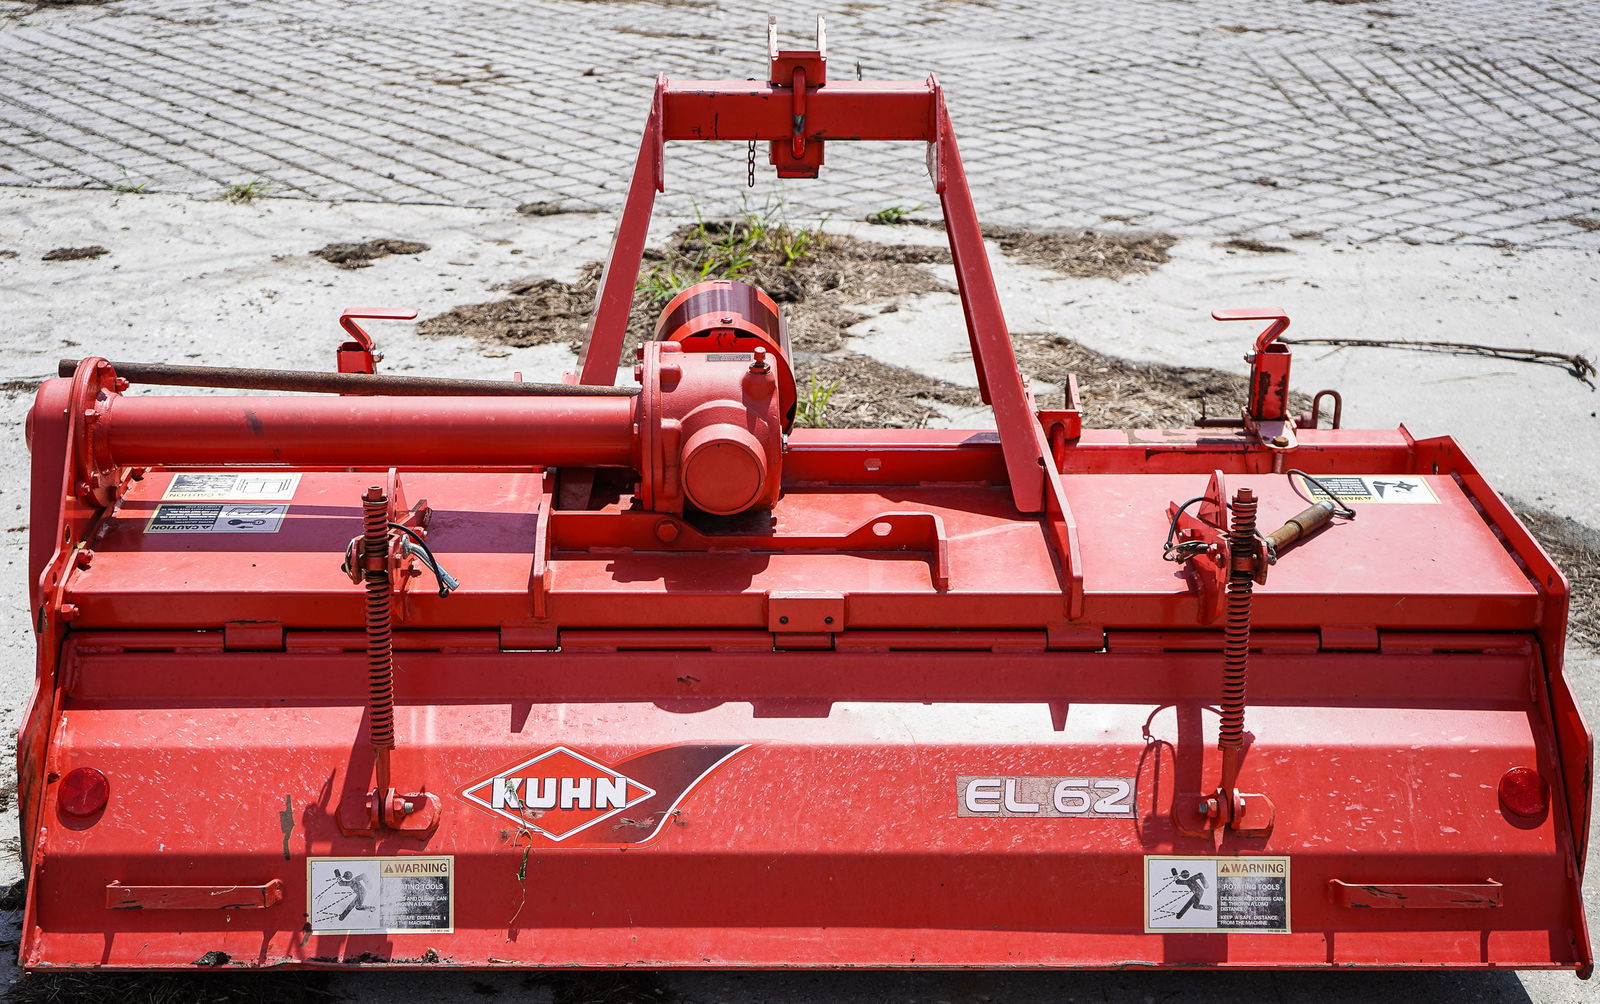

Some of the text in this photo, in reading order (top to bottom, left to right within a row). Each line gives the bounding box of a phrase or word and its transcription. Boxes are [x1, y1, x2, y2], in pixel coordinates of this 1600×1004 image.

[491, 777, 628, 810] KUHN
[965, 779, 1131, 814] EL 62
[394, 863, 448, 873] WARNING
[1231, 863, 1284, 873] WARNING
